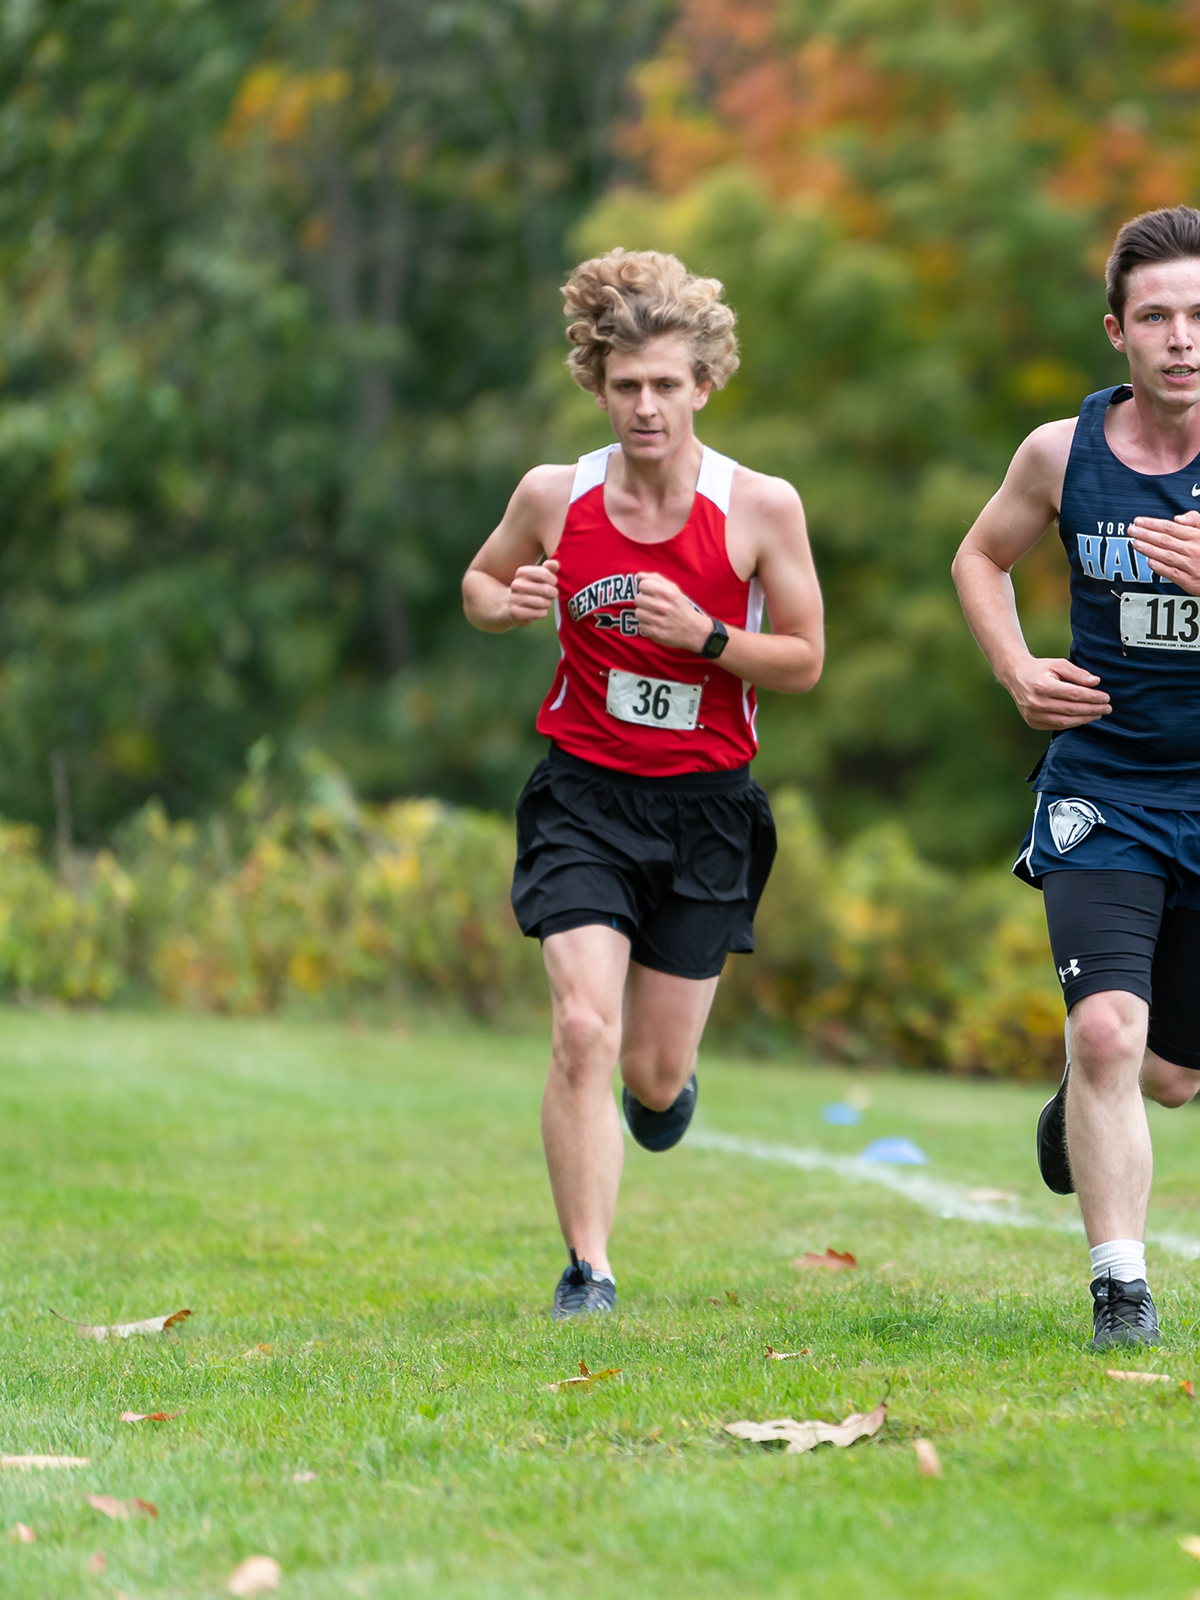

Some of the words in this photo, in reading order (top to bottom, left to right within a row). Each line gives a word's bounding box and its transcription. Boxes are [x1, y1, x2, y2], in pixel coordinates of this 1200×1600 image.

[620, 609, 646, 637] C
[1145, 598, 1199, 642] 113
[632, 679, 672, 720] 36
